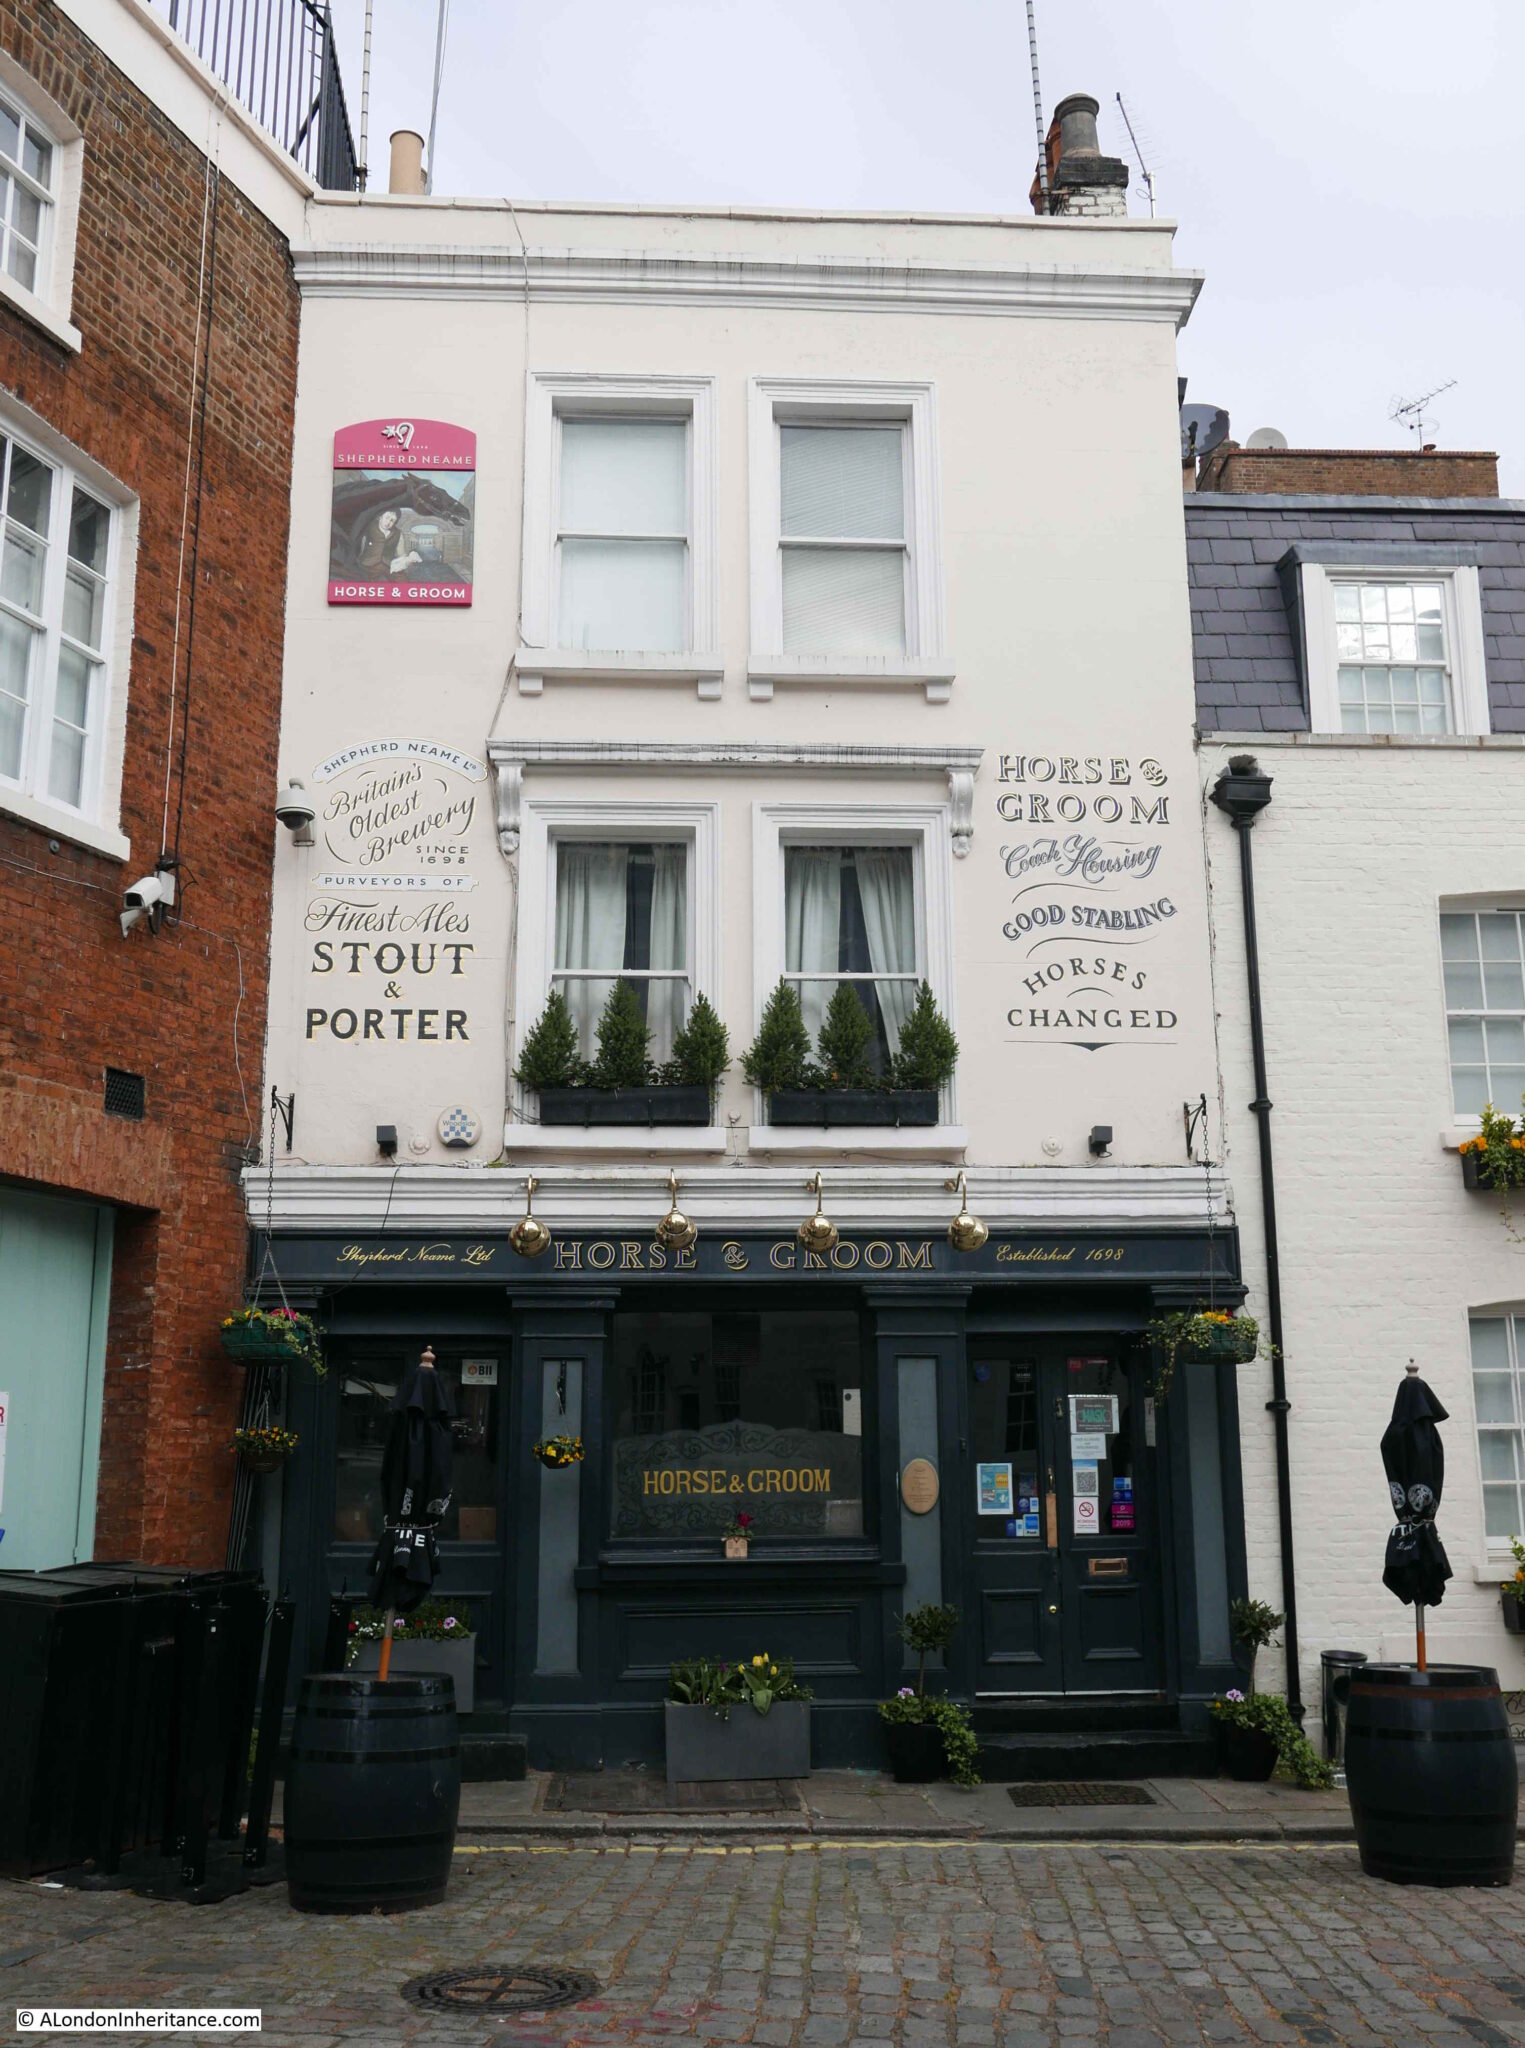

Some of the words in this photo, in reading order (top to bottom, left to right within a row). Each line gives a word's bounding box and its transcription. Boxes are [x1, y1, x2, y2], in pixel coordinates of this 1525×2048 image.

[337, 454, 417, 464] SHEPHERD
[422, 456, 472, 466] NEAME
[334, 586, 385, 598] HORSE
[392, 588, 400, 598] &
[408, 588, 466, 598] GROOM
[324, 742, 398, 774] SHEPHERD
[408, 743, 460, 764] NEAME
[996, 754, 1132, 785] HORSE
[1138, 756, 1168, 786] &
[323, 763, 422, 821] Britain's
[996, 792, 1170, 824] GROOM
[350, 790, 422, 839] Oldest
[359, 796, 476, 866] Brewery
[416, 846, 469, 854] SINCE
[420, 856, 466, 864] 1698
[1000, 838, 1062, 878] Coach
[1055, 834, 1162, 884] Housing
[324, 876, 427, 886] PURVEYORS
[442, 878, 464, 886] OF
[304, 896, 401, 932] Finest
[400, 902, 470, 933] Ales
[1002, 904, 1066, 942] GOOD
[1071, 896, 1178, 930] STABLING
[311, 942, 475, 975] STOUT
[384, 980, 404, 999] &
[1022, 957, 1148, 996] HORSES
[306, 1008, 471, 1040] PORTER
[1006, 1008, 1178, 1028] CHANGED
[336, 1244, 409, 1266] Shepherd
[408, 1243, 456, 1262] Neame
[460, 1245, 496, 1265] Ltd
[554, 1242, 698, 1270] HORSE
[720, 1241, 749, 1271] &
[770, 1242, 934, 1270] GROOM
[996, 1244, 1076, 1262] Established
[1084, 1248, 1124, 1261] 1698
[643, 1470, 727, 1495] HORSE
[728, 1474, 744, 1494] &
[747, 1468, 831, 1493] GROOM
